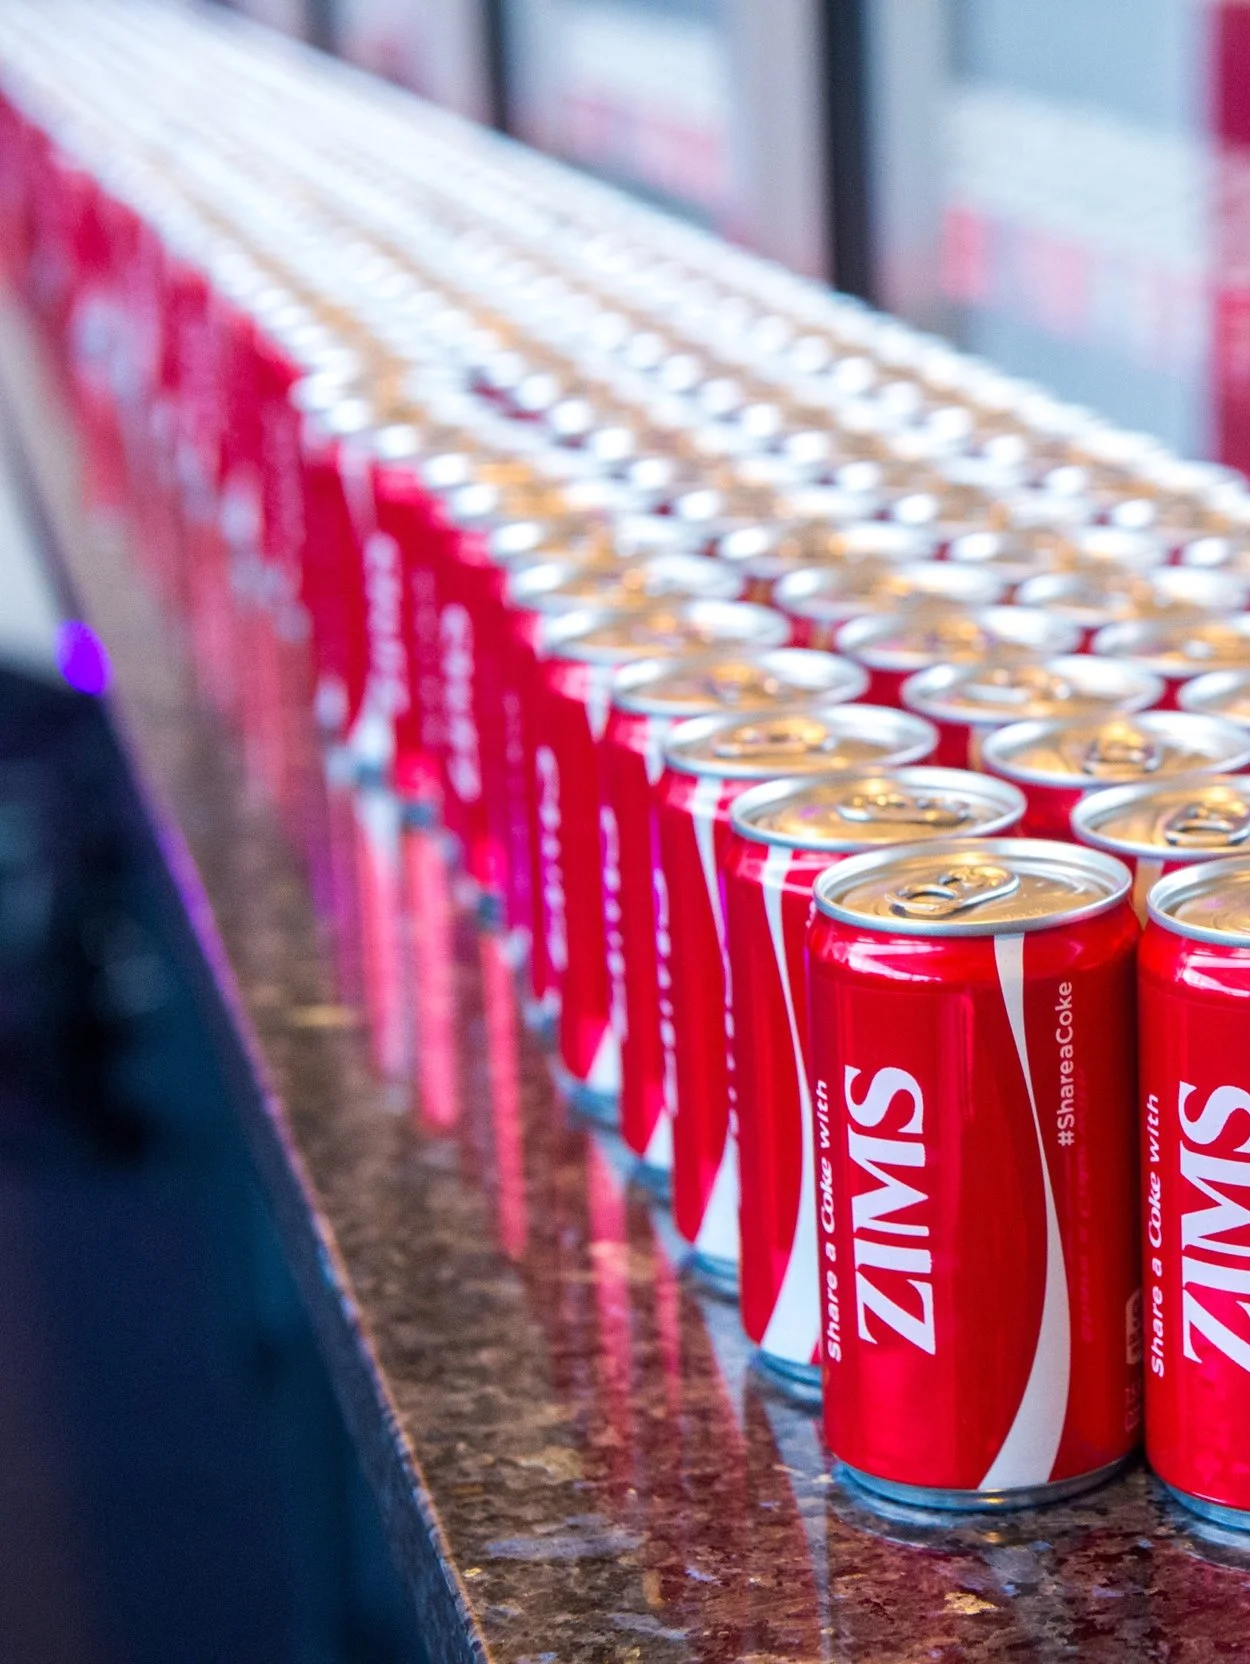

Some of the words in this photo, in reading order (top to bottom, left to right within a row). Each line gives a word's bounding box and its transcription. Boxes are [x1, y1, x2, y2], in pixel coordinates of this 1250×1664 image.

[1054, 981, 1075, 1147] #ShareaCoke
[816, 1080, 829, 1149] with
[1146, 1094, 1160, 1162] with
[820, 1157, 835, 1236] Coke
[844, 1064, 936, 1355] ZIMS
[1148, 1172, 1163, 1248] Coke
[825, 1249, 837, 1264] a
[1152, 1258, 1163, 1277] a
[825, 1271, 842, 1362] Share
[1150, 1286, 1165, 1378] Share
